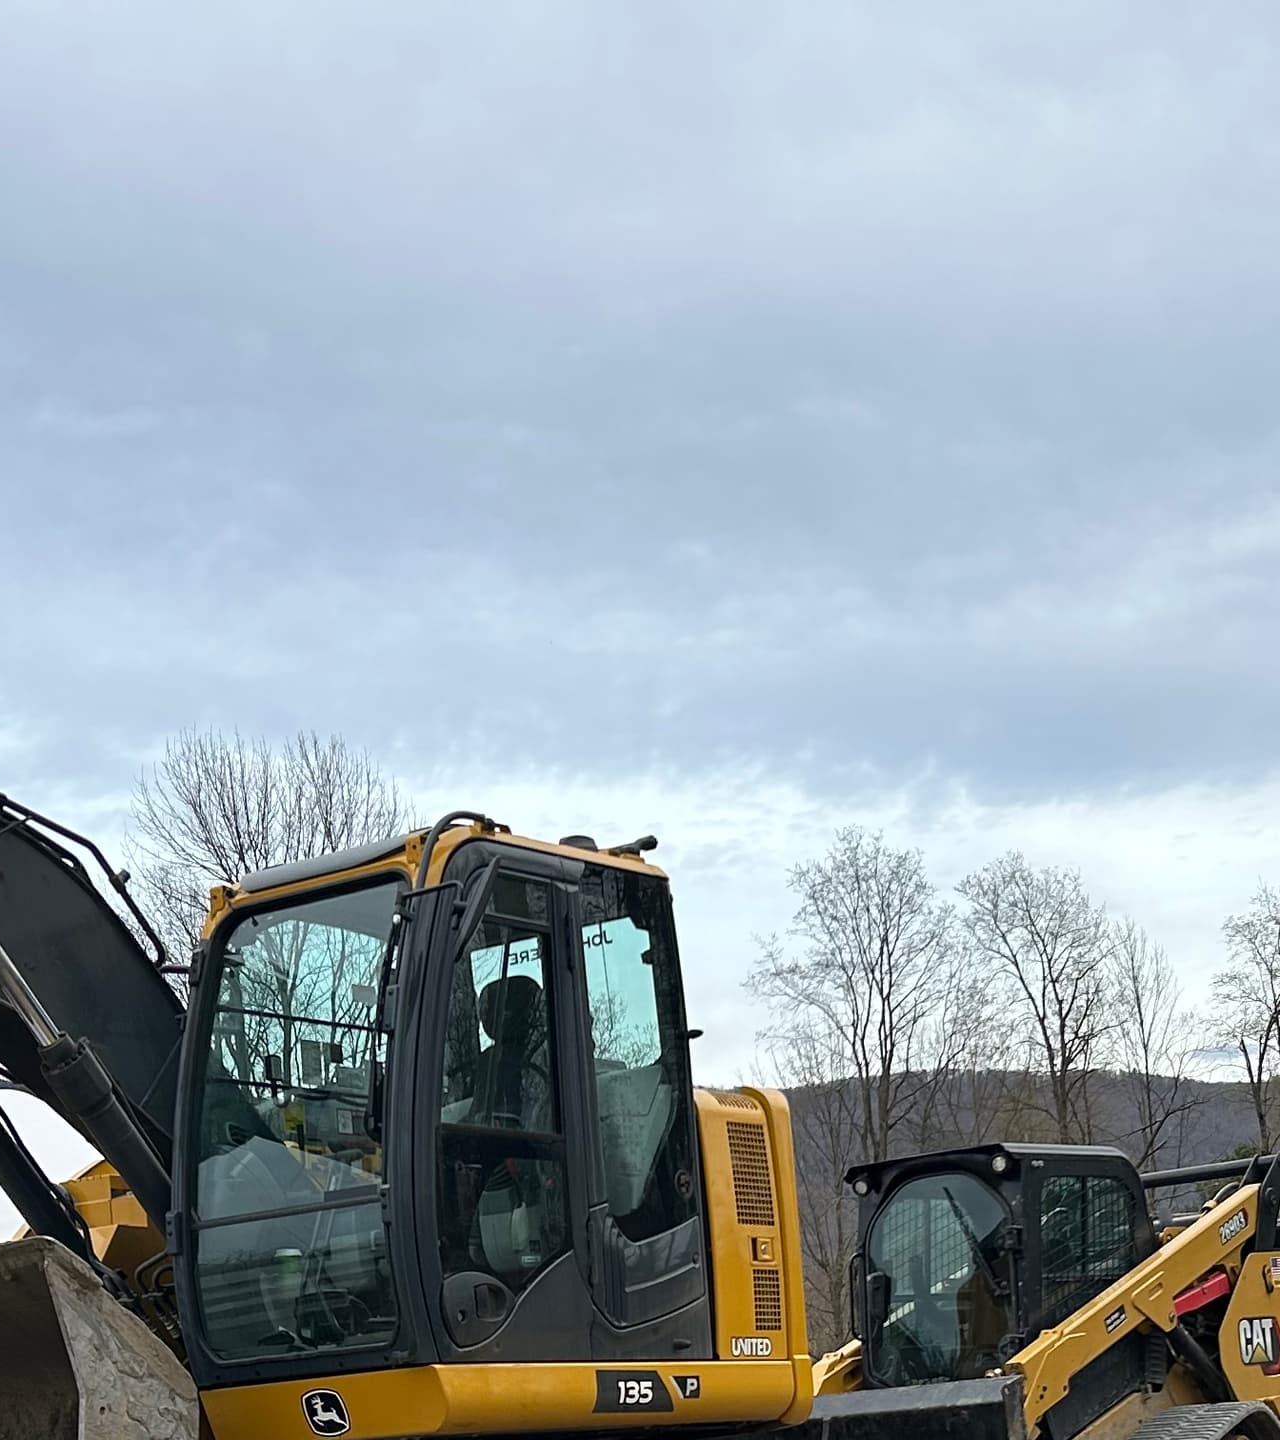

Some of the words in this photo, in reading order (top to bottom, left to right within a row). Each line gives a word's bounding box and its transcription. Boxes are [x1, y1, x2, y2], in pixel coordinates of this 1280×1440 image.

[732, 1338, 772, 1356] UNITED
[1239, 1319, 1273, 1363] CAT
[618, 1381, 653, 1404] 135
[685, 1378, 698, 1397] P
